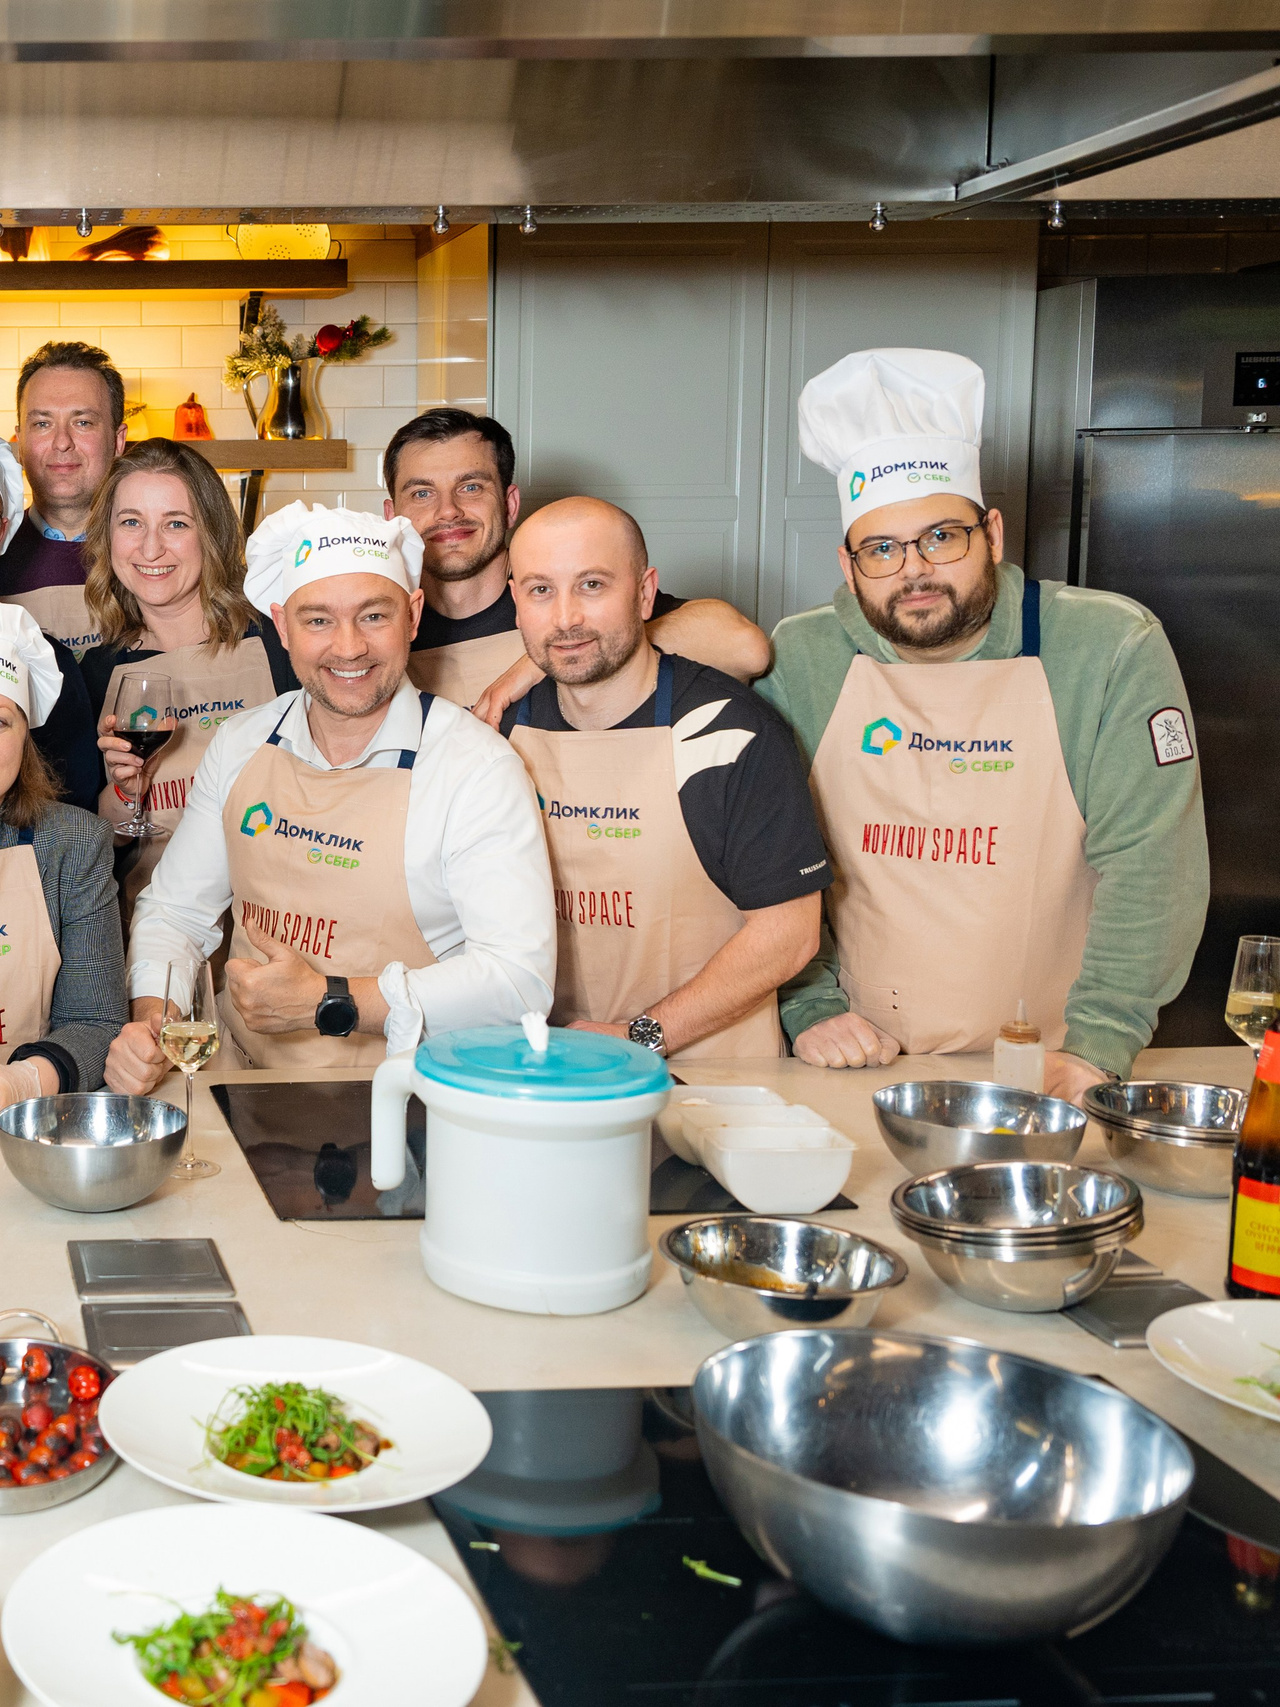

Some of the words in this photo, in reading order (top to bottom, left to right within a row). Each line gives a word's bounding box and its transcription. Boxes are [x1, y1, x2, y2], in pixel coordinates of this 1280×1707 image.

[871, 460, 949, 482] Домклик
[924, 473, 951, 482] СБЕР
[318, 536, 388, 551] Домклик
[367, 549, 390, 560] СБЕР
[0, 670, 19, 684] СБЕР
[908, 732, 1014, 752] Домклик
[971, 760, 1015, 772] СБЕР
[548, 801, 641, 820] Домклик
[274, 818, 365, 852] Домклик
[604, 827, 641, 838] СБЕР
[862, 824, 926, 860] NOVIKOV
[931, 826, 998, 865] SPACE
[324, 853, 360, 869] СБЕР
[578, 890, 635, 928] SPACE
[280, 911, 338, 959] SPACE
